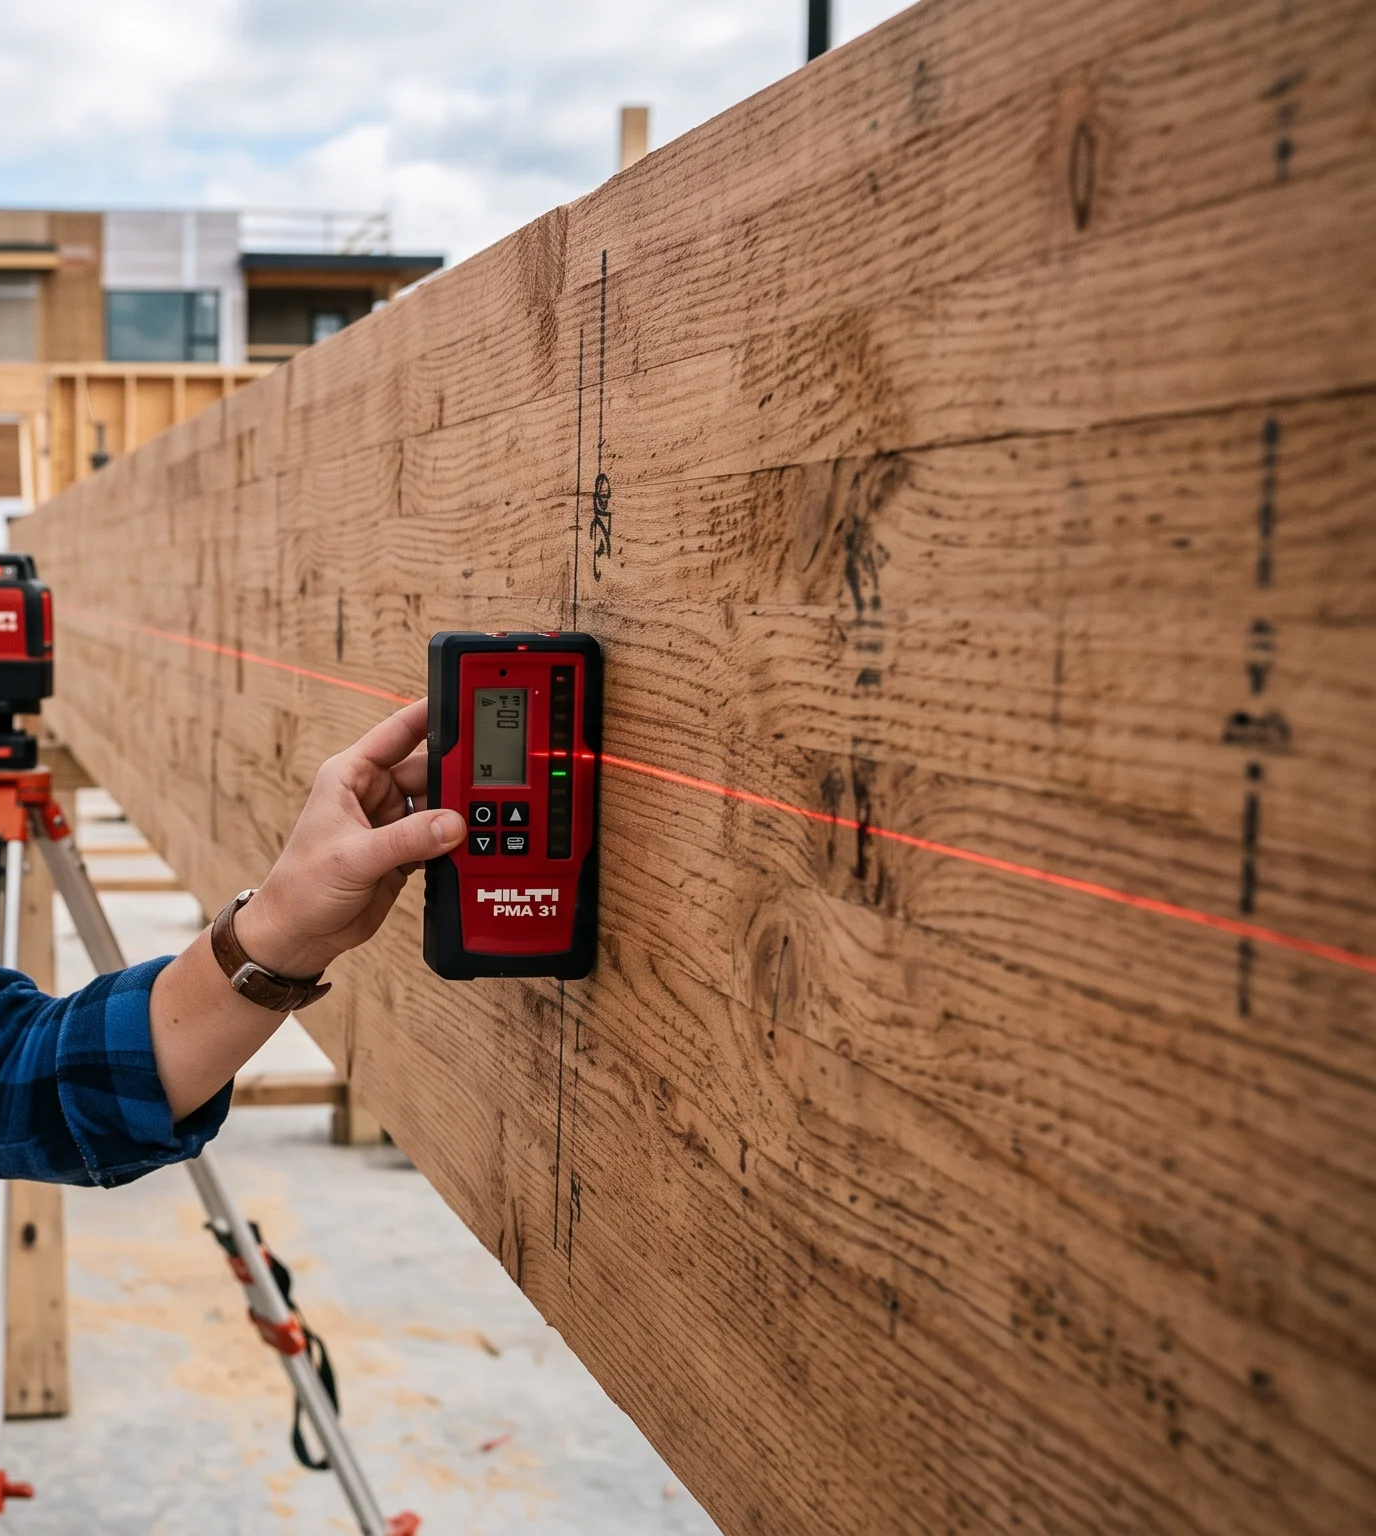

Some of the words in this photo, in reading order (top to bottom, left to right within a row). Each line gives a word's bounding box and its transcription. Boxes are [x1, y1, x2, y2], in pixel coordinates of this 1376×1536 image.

[477, 888, 559, 902] HILTI
[493, 905, 533, 917] PMA
[538, 905, 557, 917] 31
